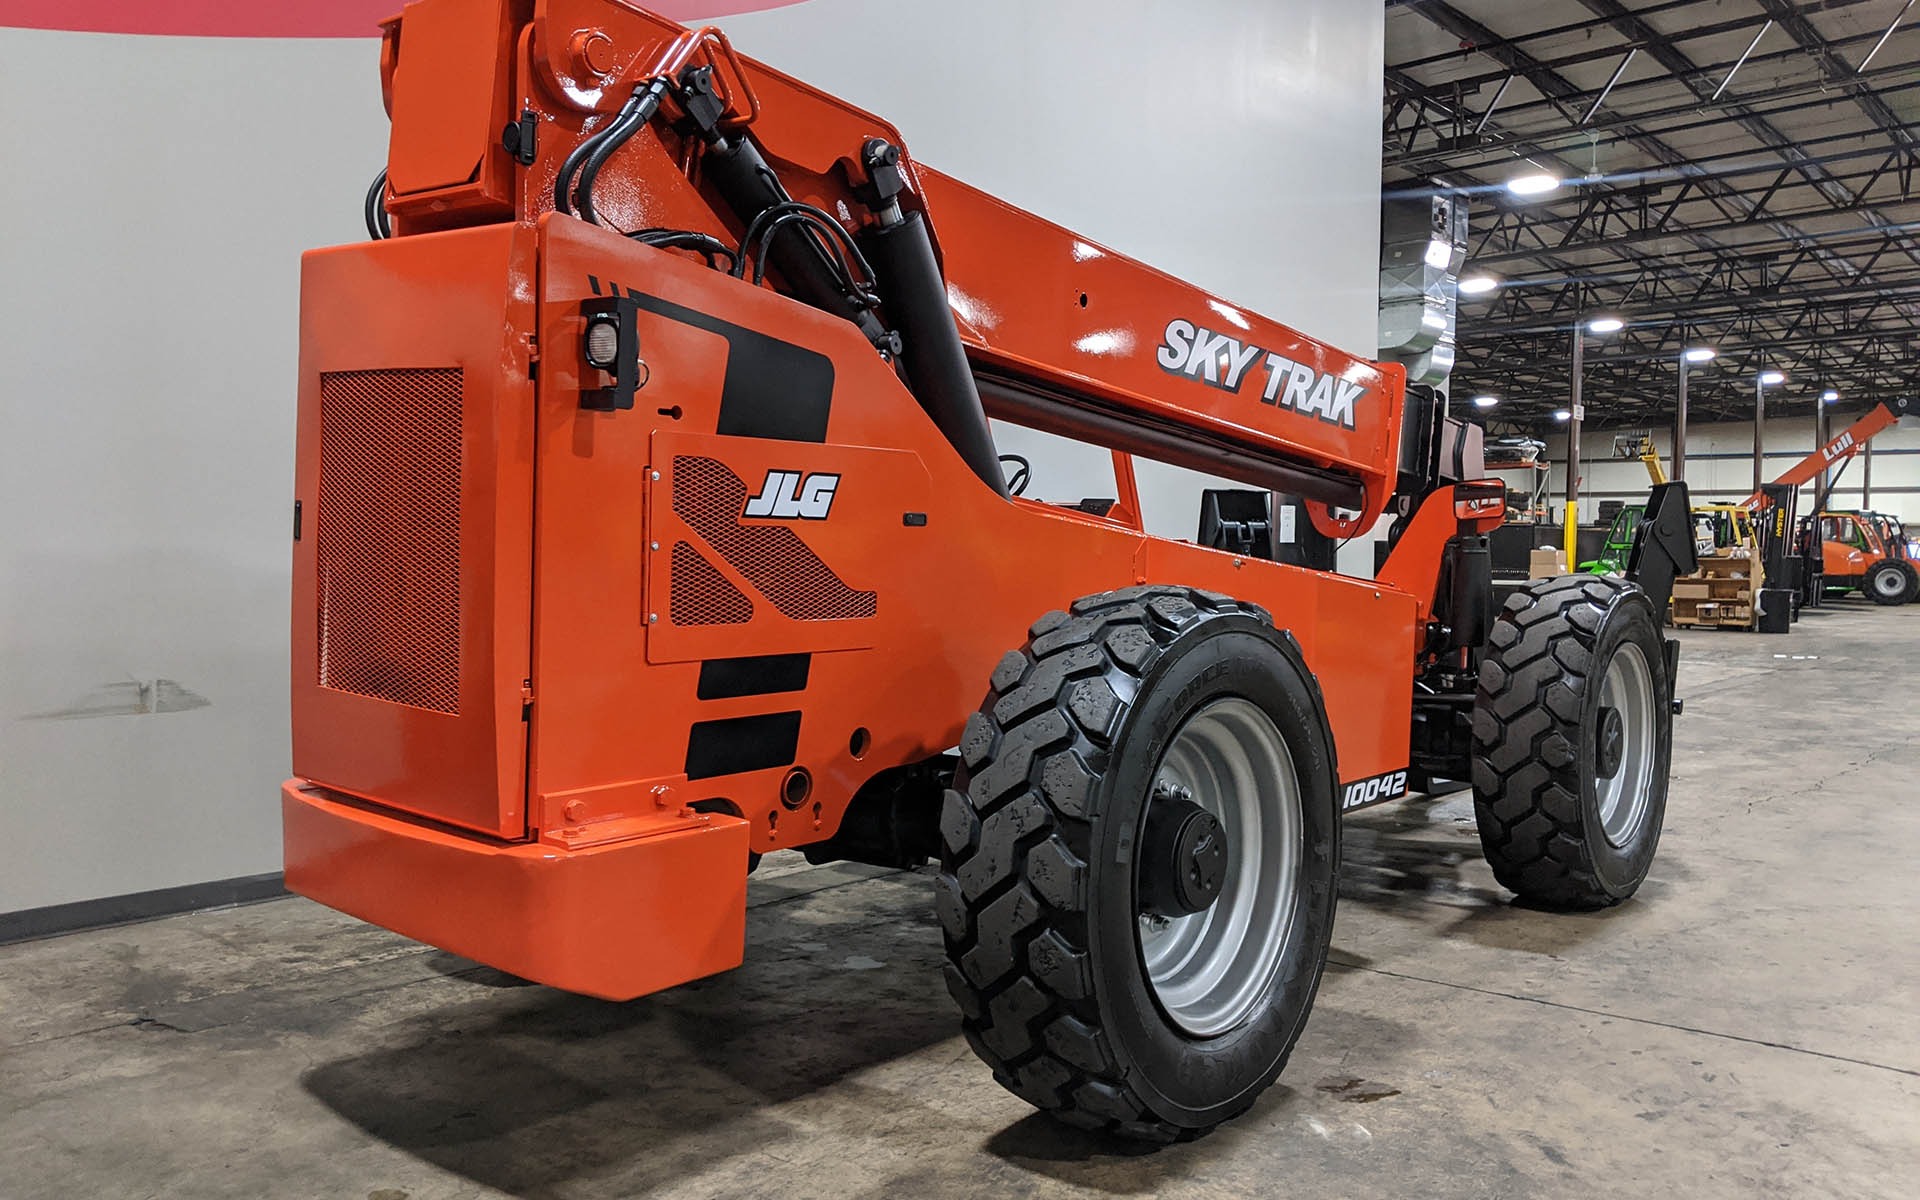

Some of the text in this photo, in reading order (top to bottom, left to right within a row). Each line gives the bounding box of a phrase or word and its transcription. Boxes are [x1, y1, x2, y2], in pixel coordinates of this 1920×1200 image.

[1156, 318, 1367, 431] SKY TRAK
[1822, 431, 1854, 461] Lull
[742, 469, 841, 520] JLG
[1775, 507, 1785, 538] HYSTER
[1342, 771, 1407, 809] 10042
